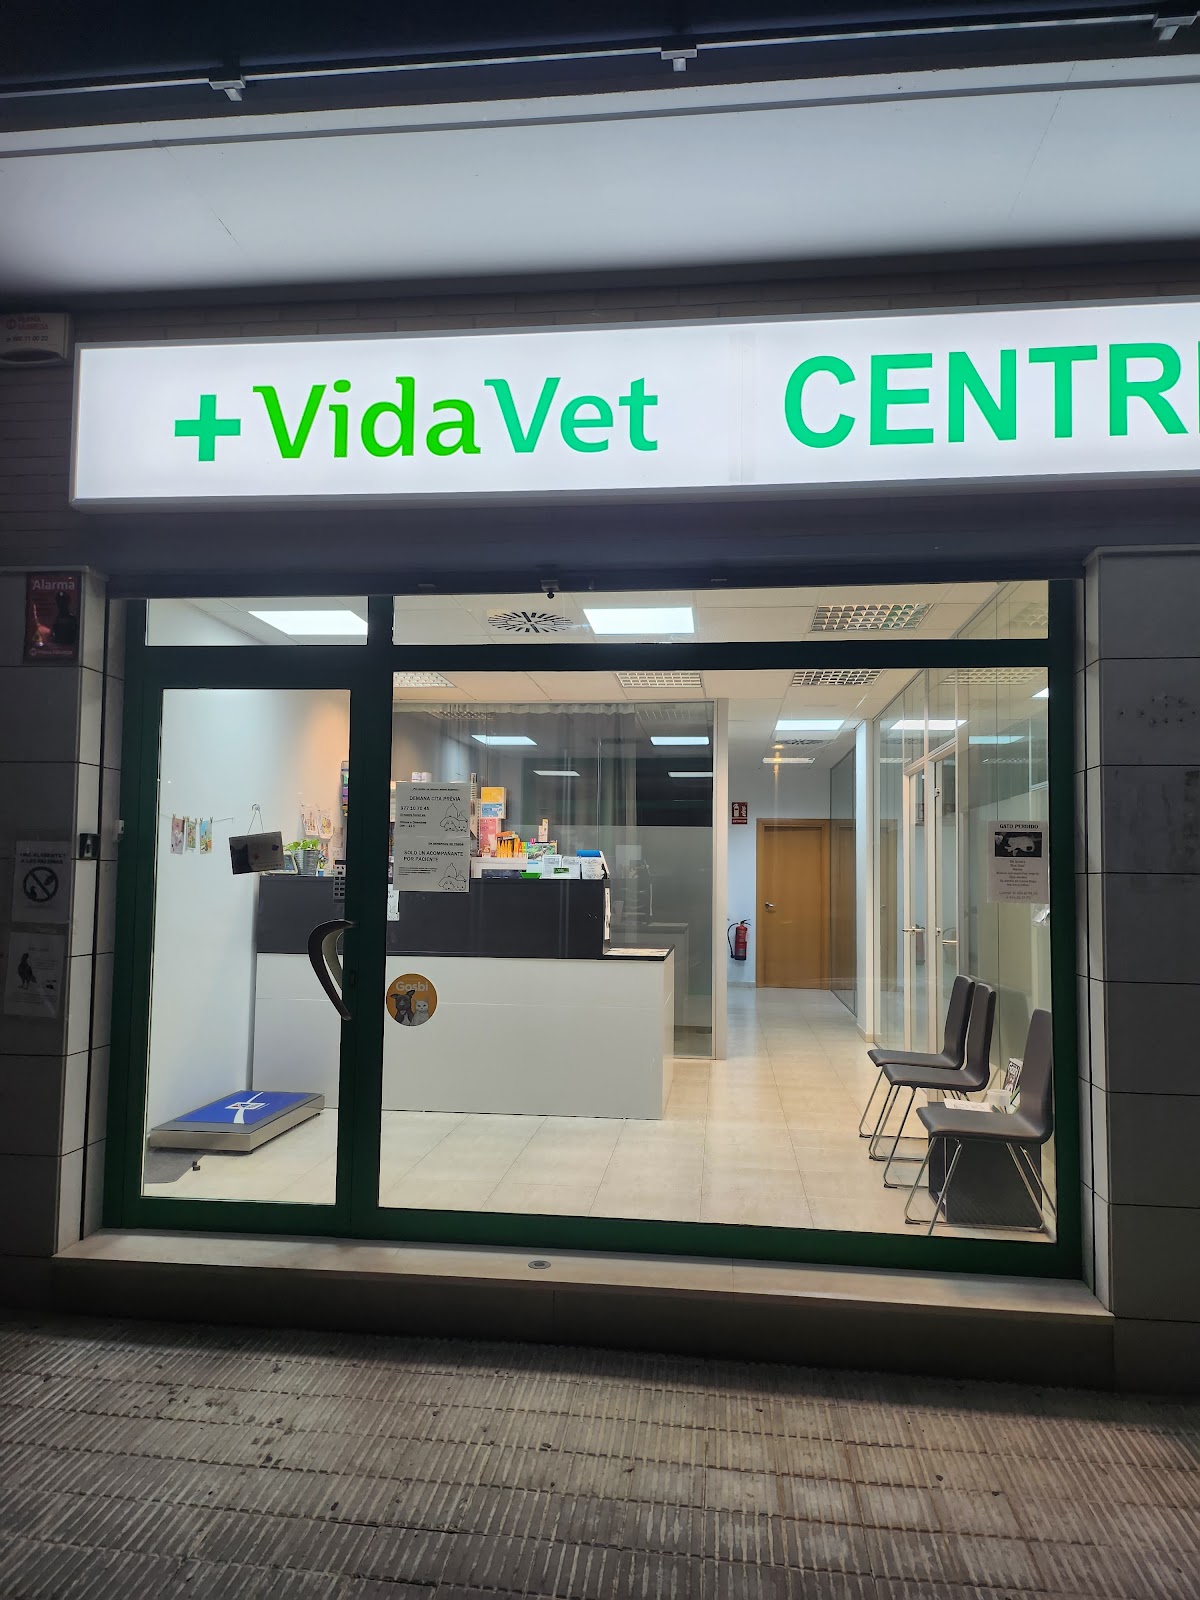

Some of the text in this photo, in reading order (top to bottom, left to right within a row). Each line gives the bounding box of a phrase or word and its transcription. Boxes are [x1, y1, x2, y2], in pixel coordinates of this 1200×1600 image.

[784, 343, 1200, 448] CENTR
[32, 578, 75, 591] Alarma
[395, 981, 429, 992] Gosbi
